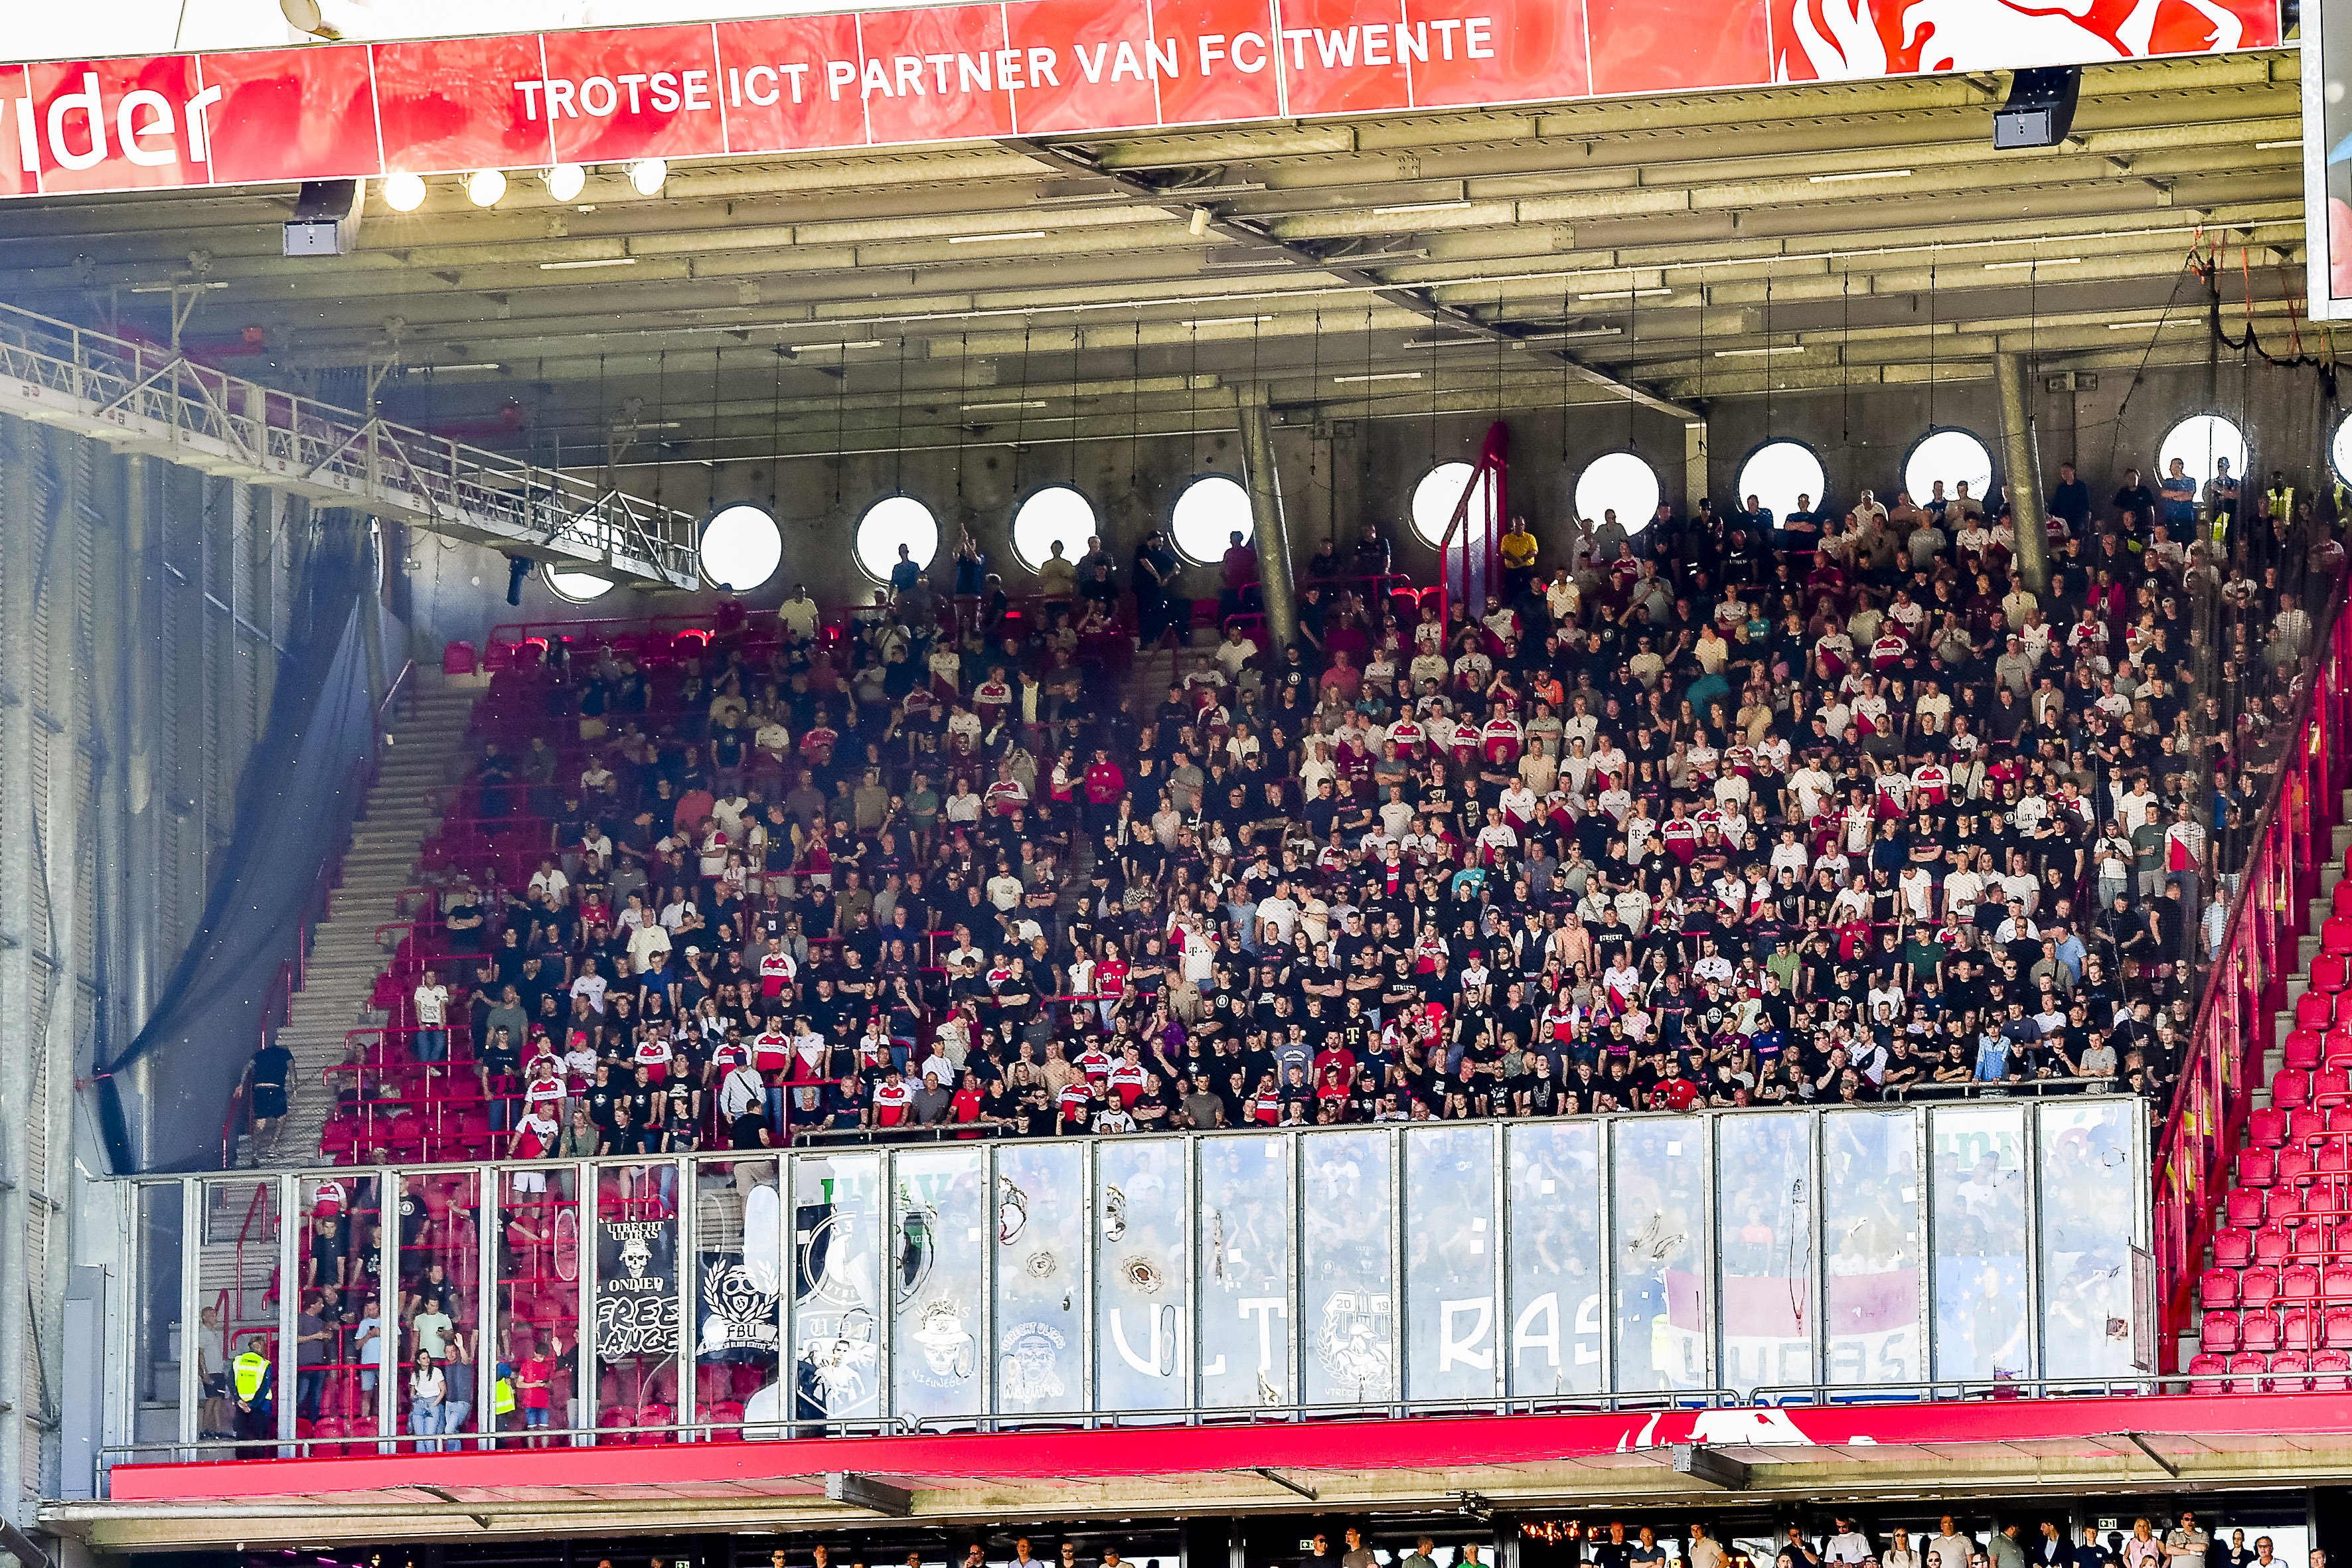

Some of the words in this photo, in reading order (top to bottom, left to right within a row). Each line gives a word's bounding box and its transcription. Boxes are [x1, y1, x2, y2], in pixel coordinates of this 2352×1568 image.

[514, 70, 712, 121] TROTSE
[728, 62, 809, 108] ICT
[826, 46, 1060, 102] PARTNER
[1073, 37, 1179, 84] VAN
[1199, 31, 1267, 76] FC
[1283, 17, 1494, 70] TWENTE
[0, 72, 222, 171] ider
[607, 1221, 664, 1233] UTRECHT
[612, 1230, 659, 1241] ULTRAS
[609, 1277, 664, 1293] ONDIEP
[1336, 1299, 1351, 1308] 20
[726, 1325, 756, 1338] FBU
[1000, 1321, 1037, 1351] UTRECHT
